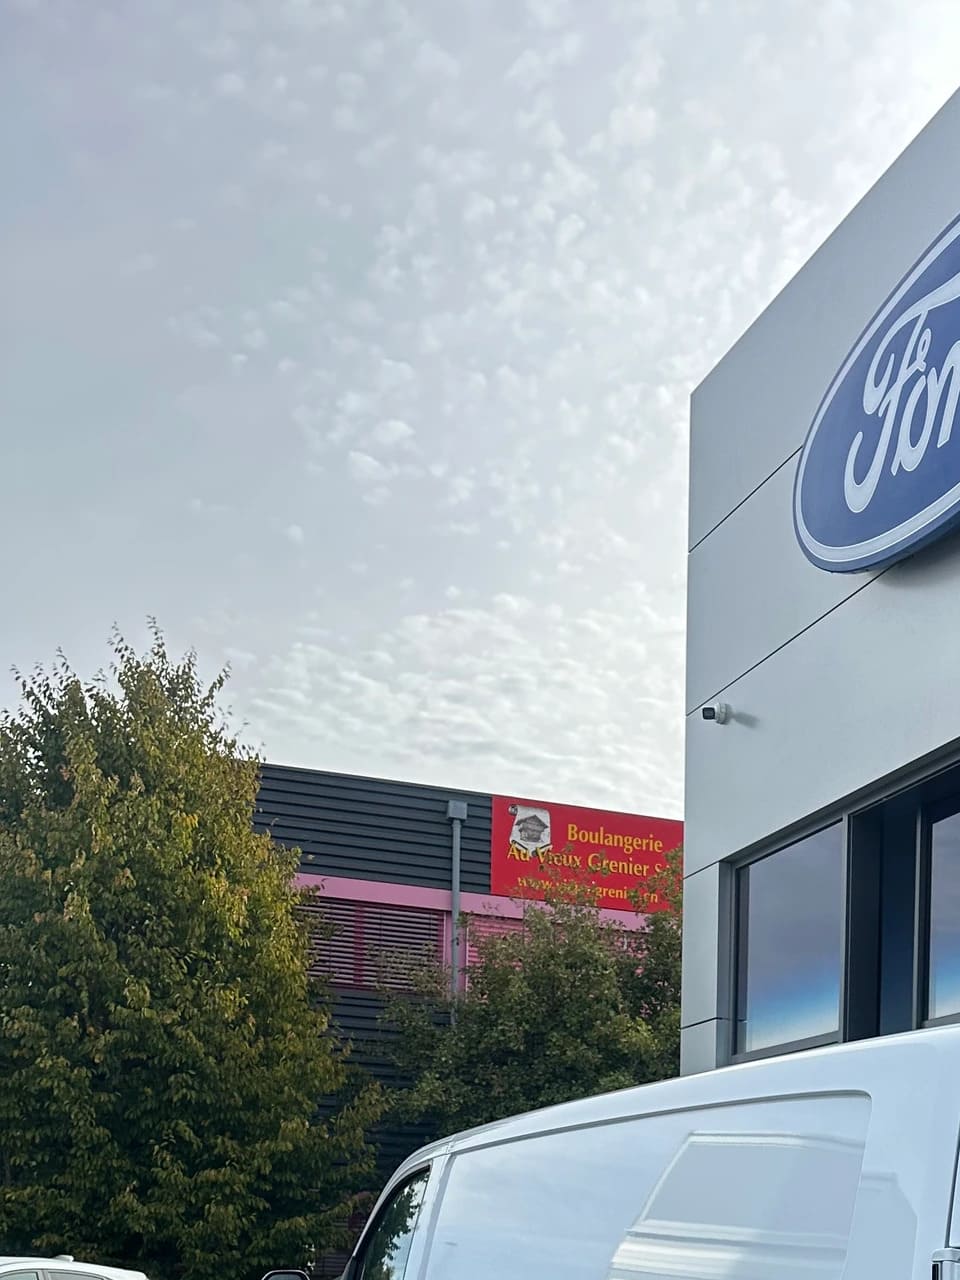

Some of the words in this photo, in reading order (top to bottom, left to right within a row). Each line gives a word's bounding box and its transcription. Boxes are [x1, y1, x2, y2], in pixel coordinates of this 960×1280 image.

[567, 823, 664, 855] Boulangerie
[507, 842, 531, 862] Au
[588, 853, 650, 877] Grenier
